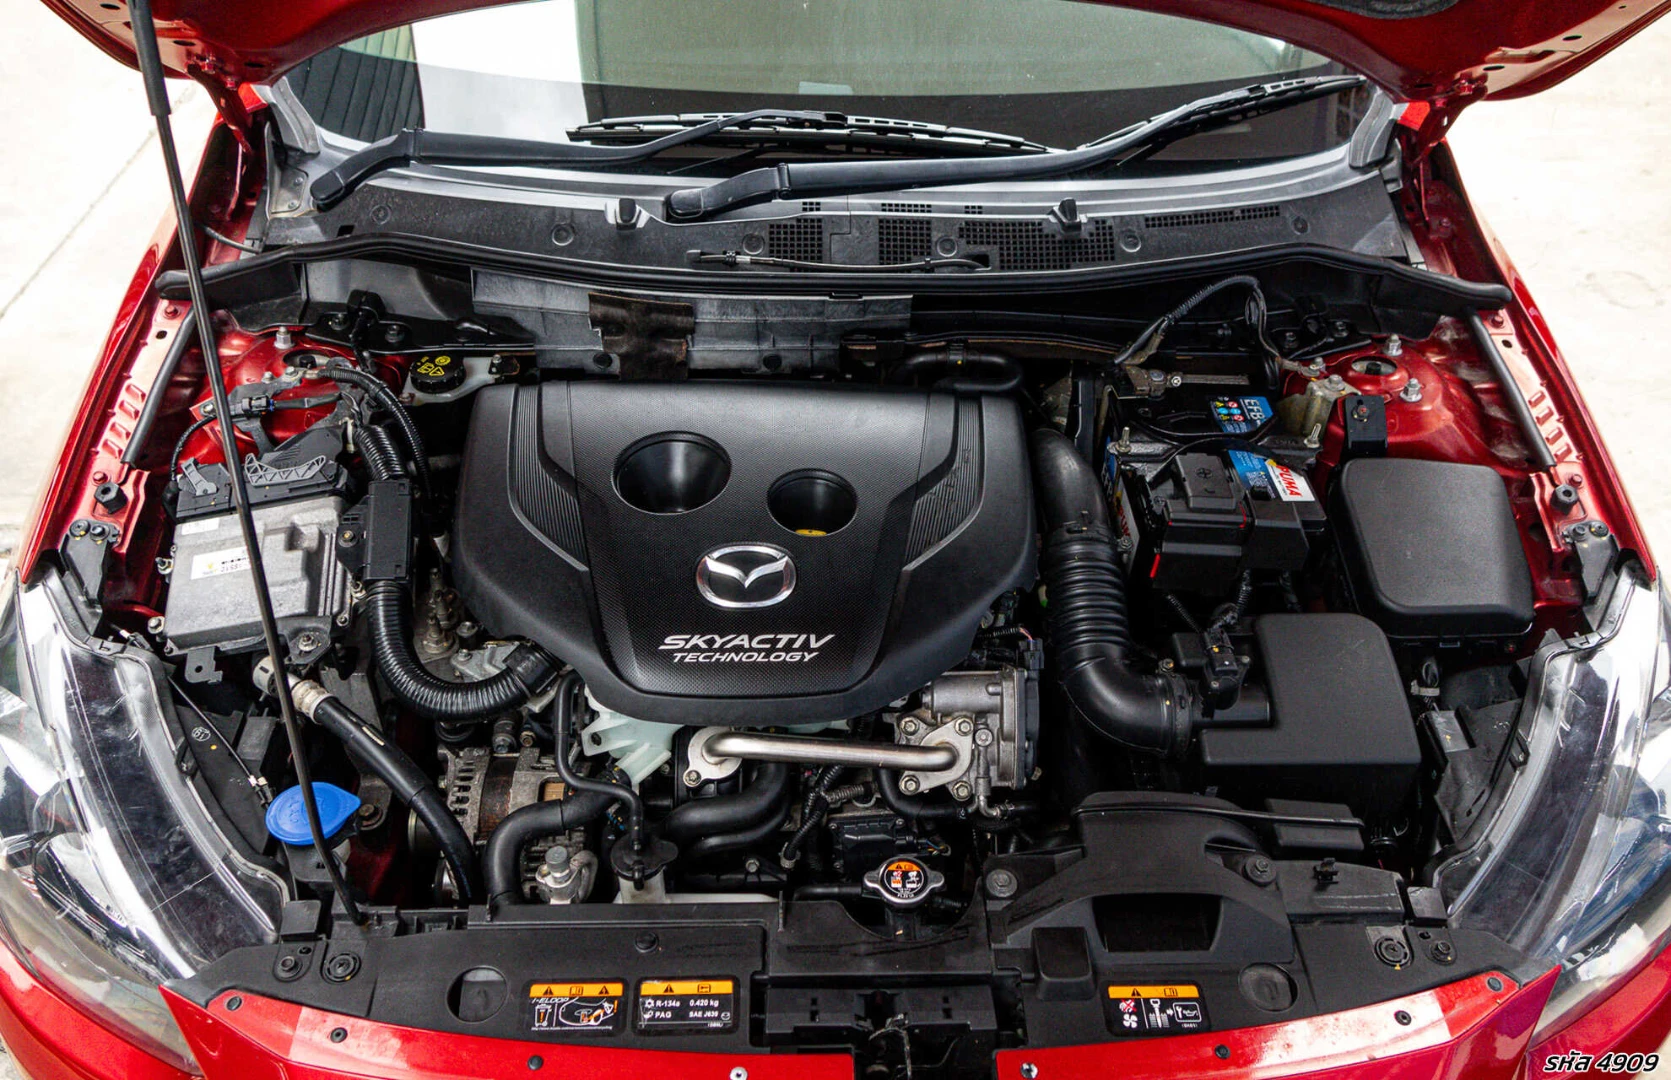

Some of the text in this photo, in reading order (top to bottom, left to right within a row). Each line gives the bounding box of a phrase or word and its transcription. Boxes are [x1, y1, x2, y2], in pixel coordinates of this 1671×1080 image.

[1243, 398, 1266, 420] EFB
[1276, 464, 1303, 498] PUMA
[658, 634, 836, 650] SKYACTIV
[673, 652, 820, 663] TECHNOLOGY
[655, 999, 719, 1008] R-134a 0.420 kg
